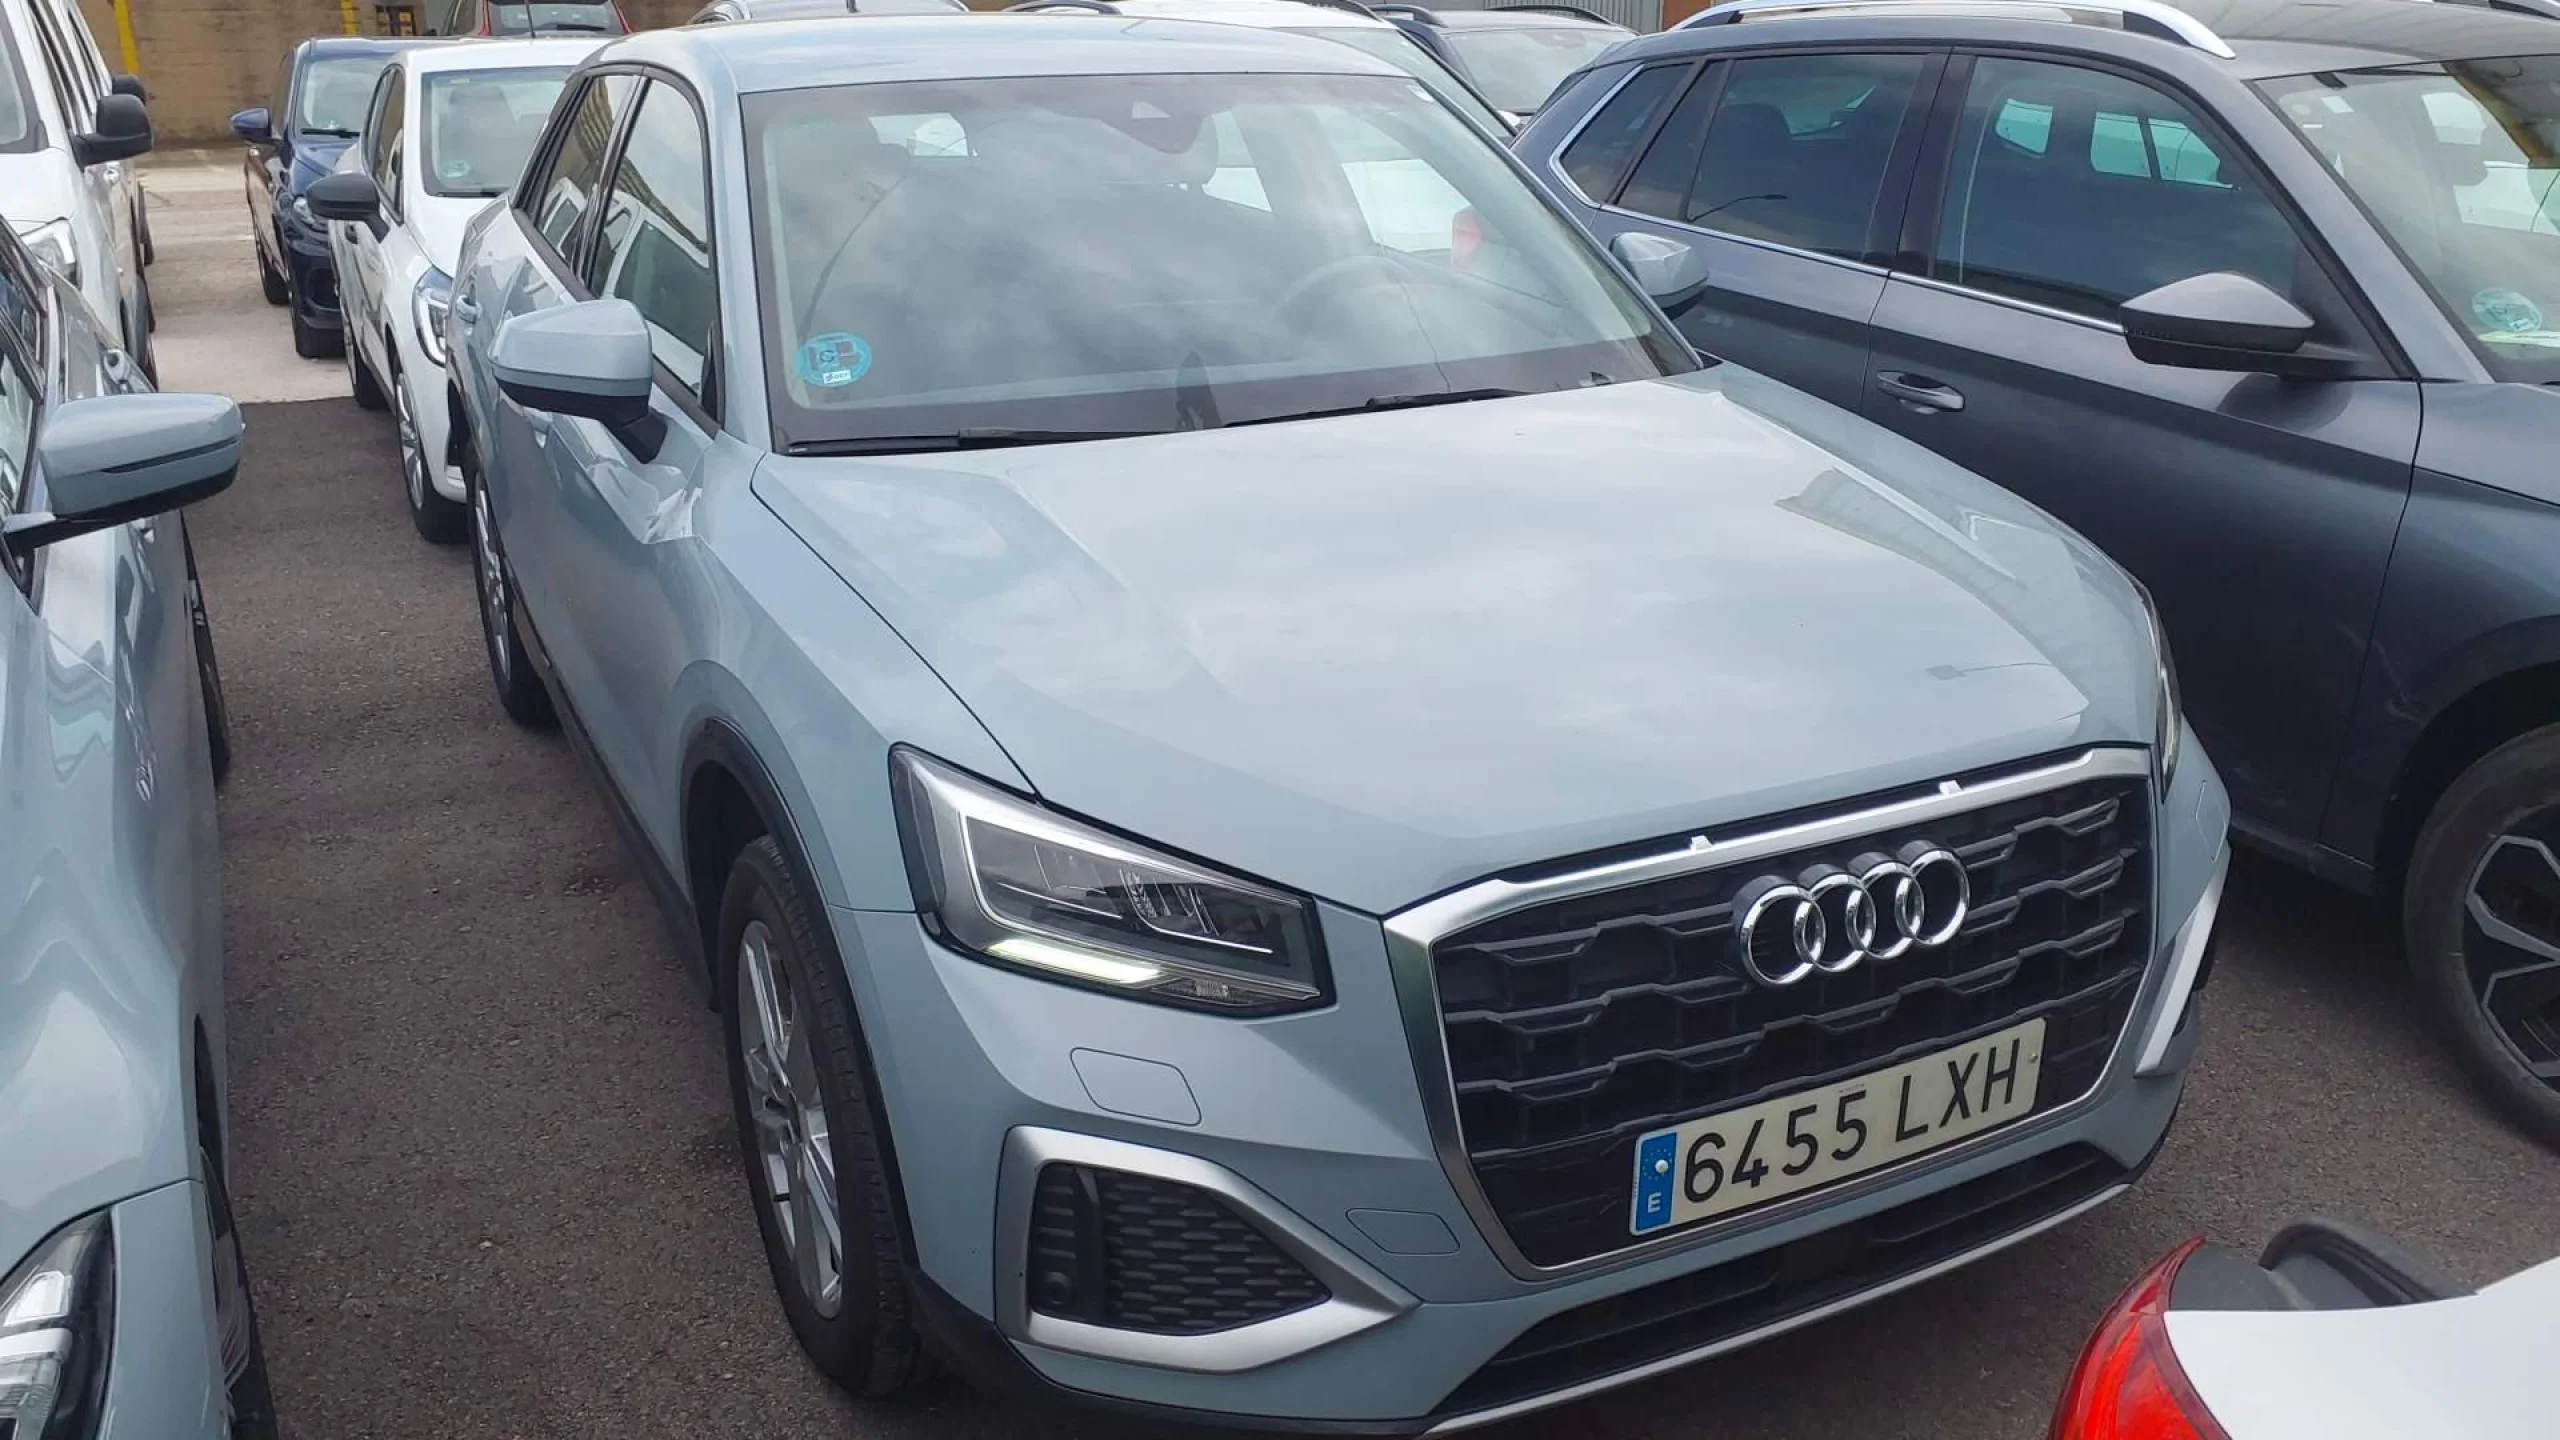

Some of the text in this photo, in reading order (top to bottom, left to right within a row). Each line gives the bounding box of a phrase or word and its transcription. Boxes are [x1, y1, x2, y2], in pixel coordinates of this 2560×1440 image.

[1682, 1038, 2020, 1203] 6455 LXH
[1647, 1192, 1662, 1213] E
